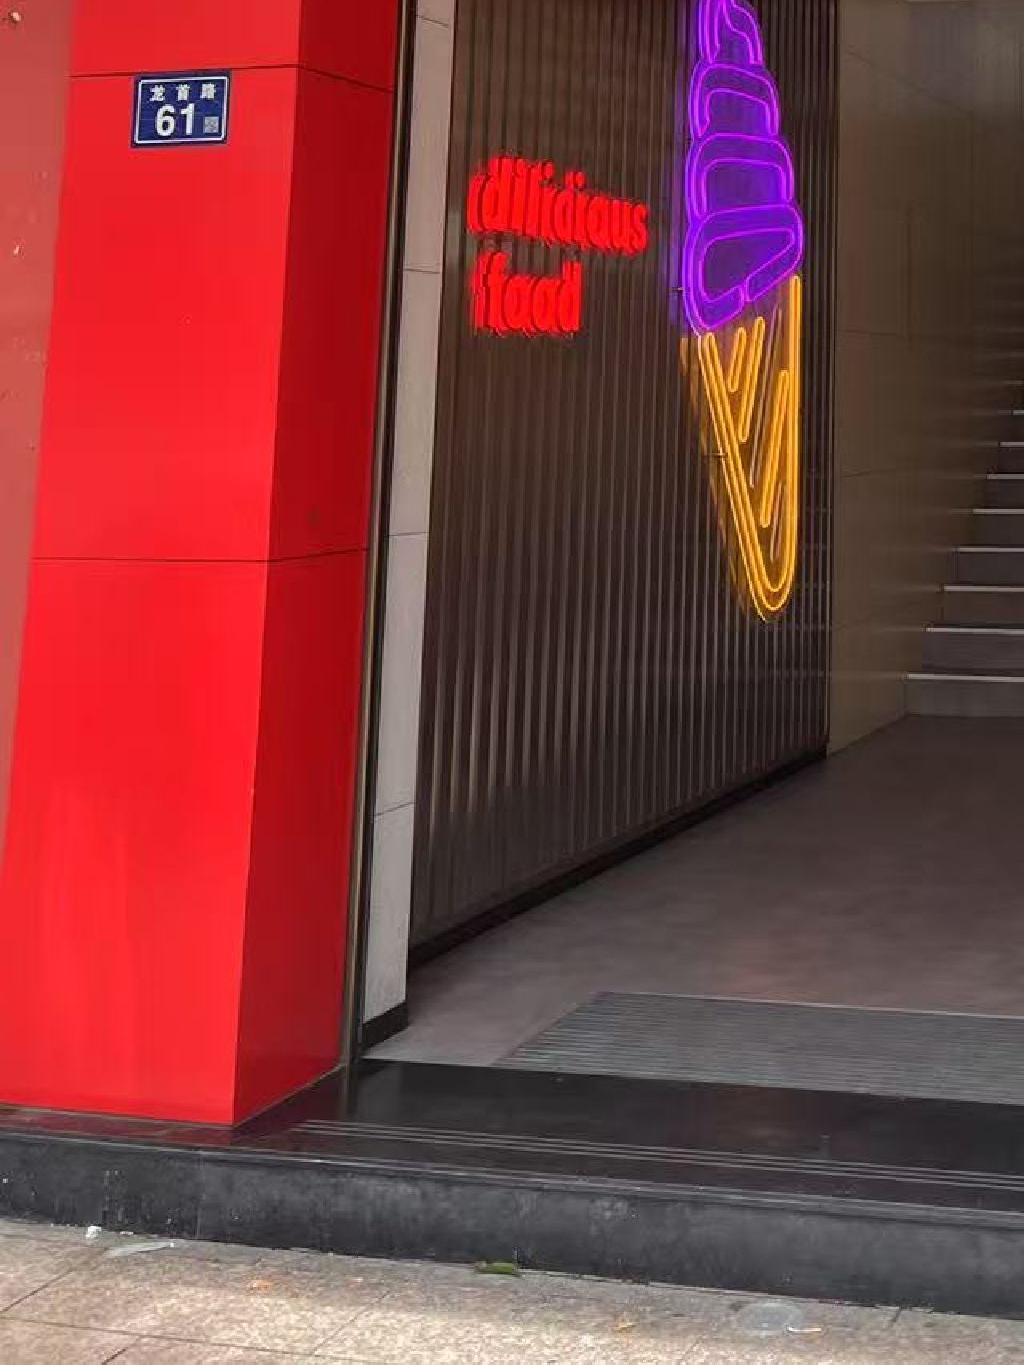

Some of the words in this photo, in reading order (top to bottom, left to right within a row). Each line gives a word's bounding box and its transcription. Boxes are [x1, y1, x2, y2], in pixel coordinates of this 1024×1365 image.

[149, 83, 216, 102] 龙首路
[156, 103, 195, 136] 61
